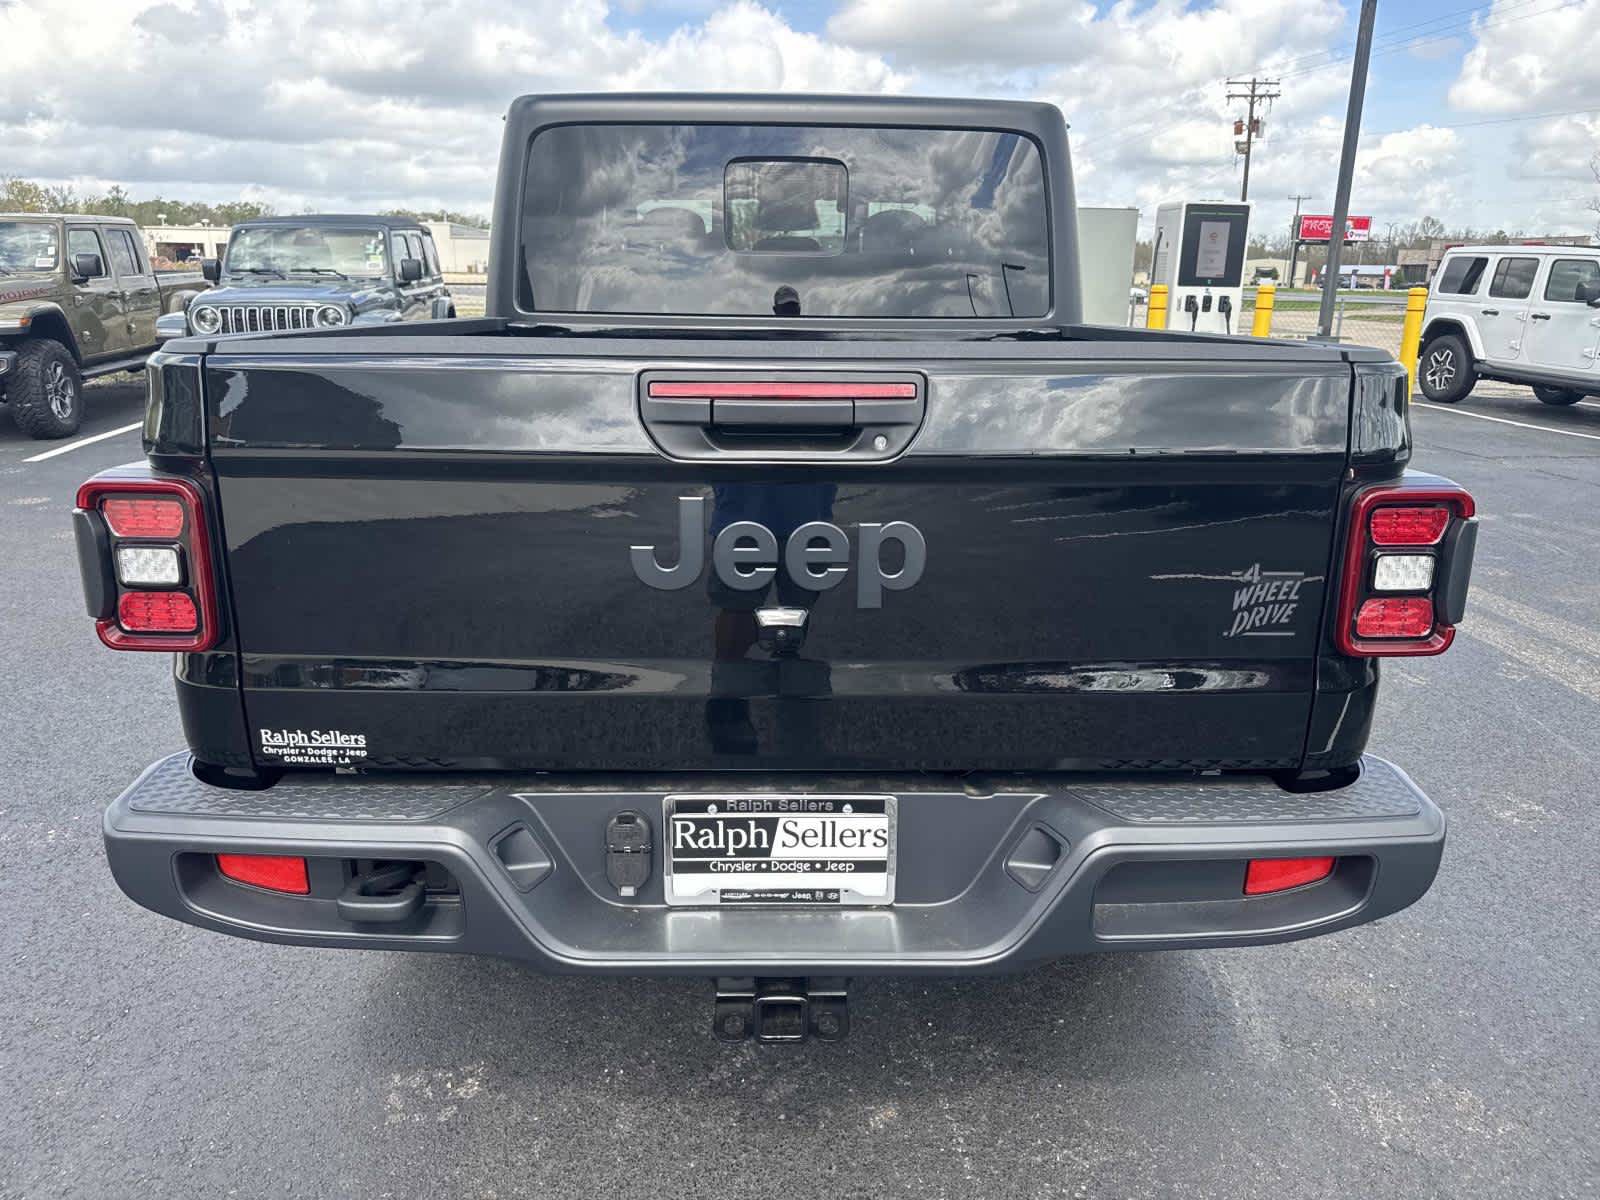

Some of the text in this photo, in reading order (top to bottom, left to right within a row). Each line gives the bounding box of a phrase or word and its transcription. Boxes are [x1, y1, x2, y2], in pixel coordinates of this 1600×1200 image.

[630, 496, 926, 608] Jeep
[1240, 563, 1261, 583] 4
[1232, 580, 1301, 611] WHEEL
[1229, 603, 1298, 637] DRIVE
[260, 729, 365, 746] Ralph Sellers
[262, 746, 367, 757] Chrysler Dodge Jeep
[726, 799, 834, 813] Ralph Sellers
[673, 820, 888, 856] Ralph Sellers
[709, 861, 854, 873] Chrysler Dodge Jeep
